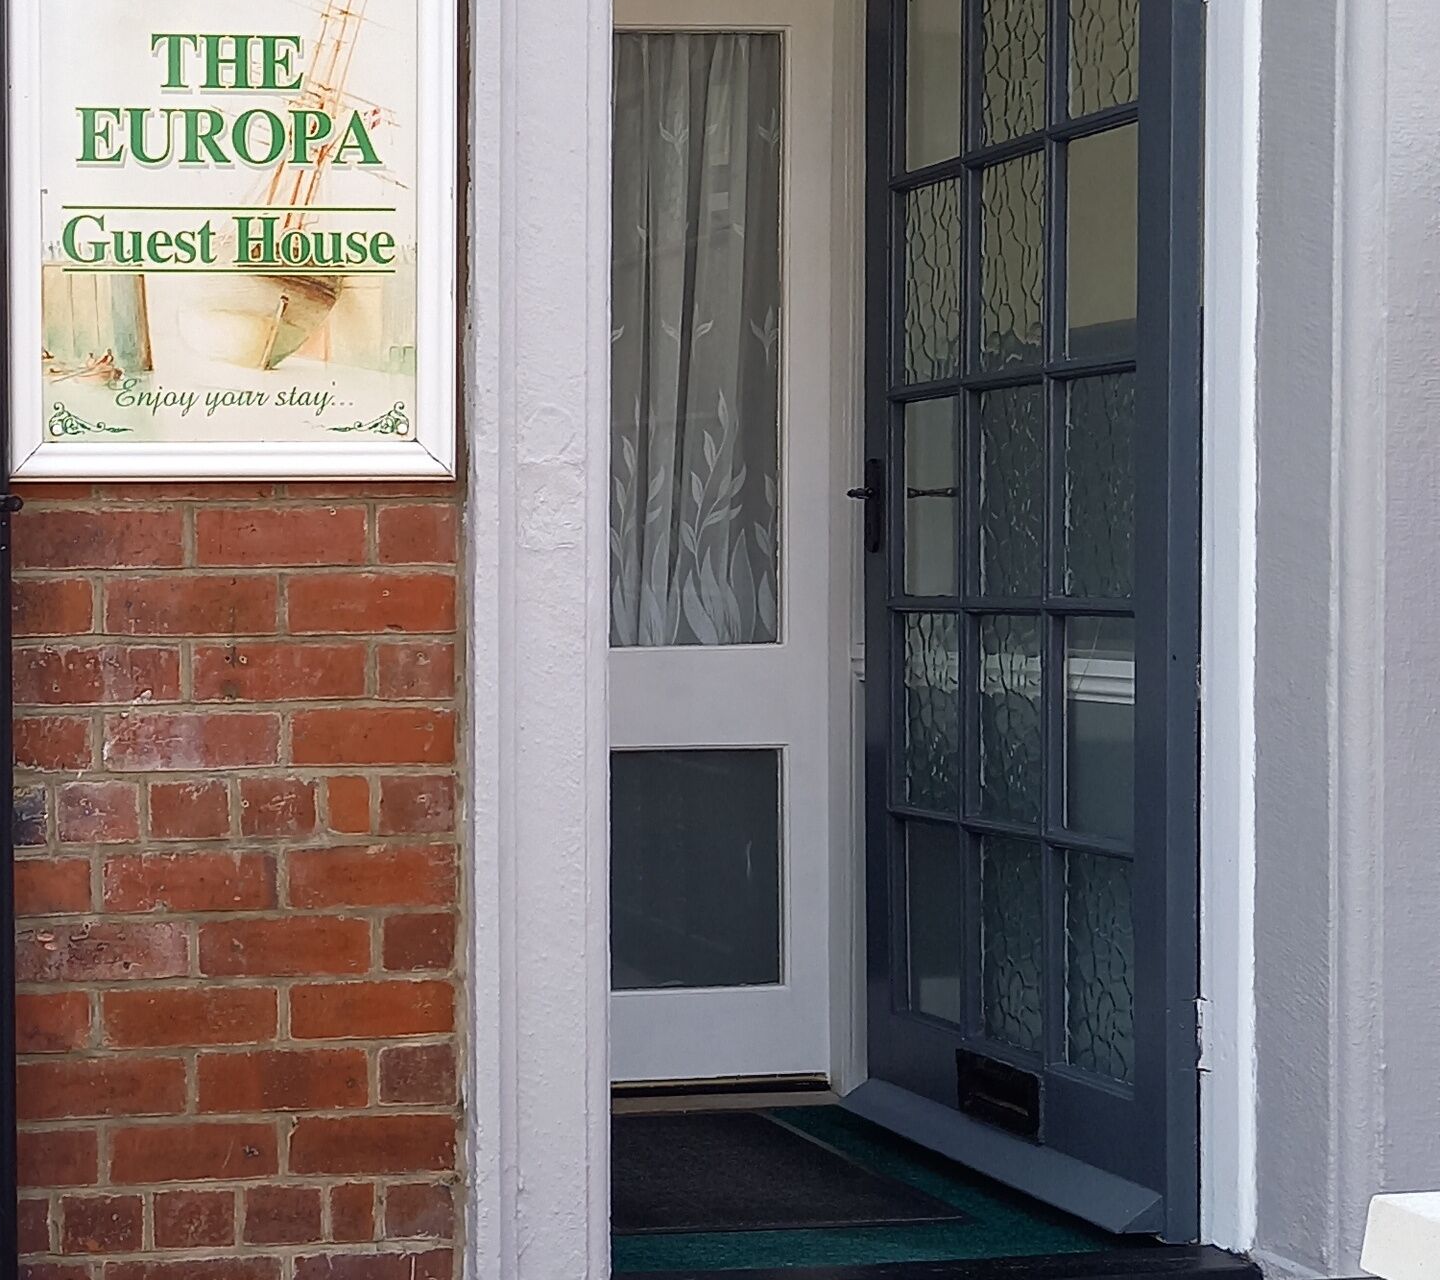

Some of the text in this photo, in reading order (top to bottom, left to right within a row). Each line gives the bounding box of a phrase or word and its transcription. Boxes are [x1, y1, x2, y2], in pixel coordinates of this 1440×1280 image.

[151, 33, 303, 90] THE
[76, 107, 383, 166] EUROPA
[62, 213, 397, 266] Guest House
[110, 378, 201, 417] Enjoy
[205, 389, 270, 417] your
